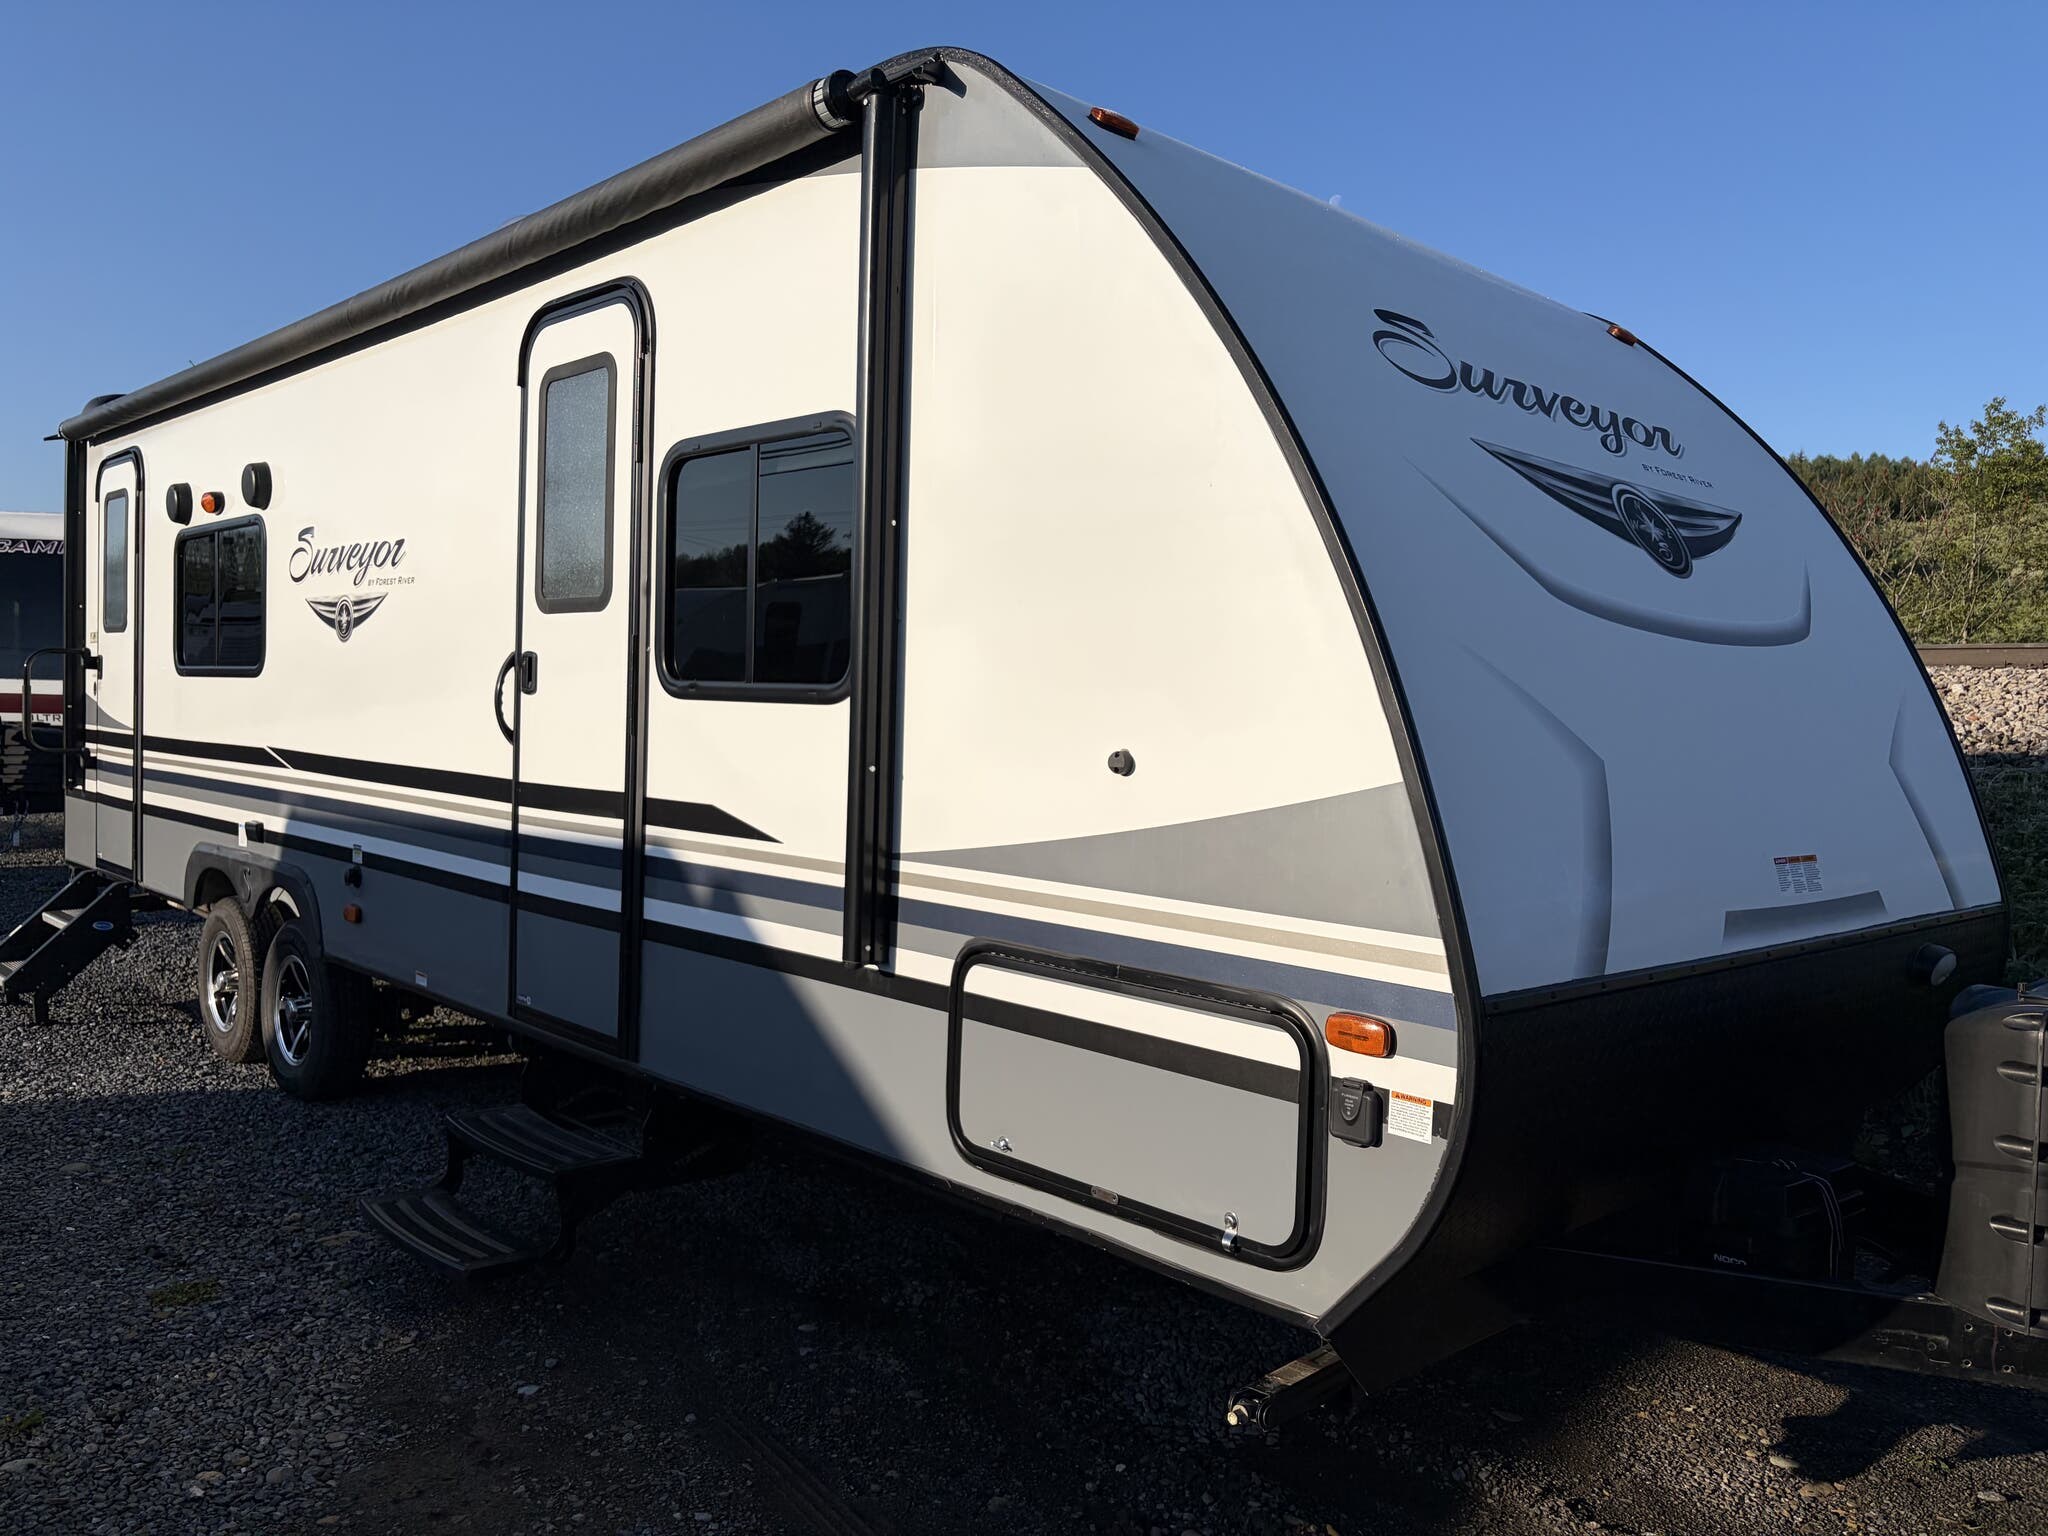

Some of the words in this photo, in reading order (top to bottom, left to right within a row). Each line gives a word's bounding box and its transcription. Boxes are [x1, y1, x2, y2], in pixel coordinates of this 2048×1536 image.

[1372, 308, 1683, 457] Surveyor
[1642, 463, 1653, 473] BY
[1654, 466, 1688, 481] FOREST
[1688, 475, 1714, 488] RIVER
[289, 526, 406, 586] Surveyor
[375, 577, 397, 586] FOREST
[397, 576, 415, 585] RIVER
[1400, 1094, 1427, 1106] WARNING
